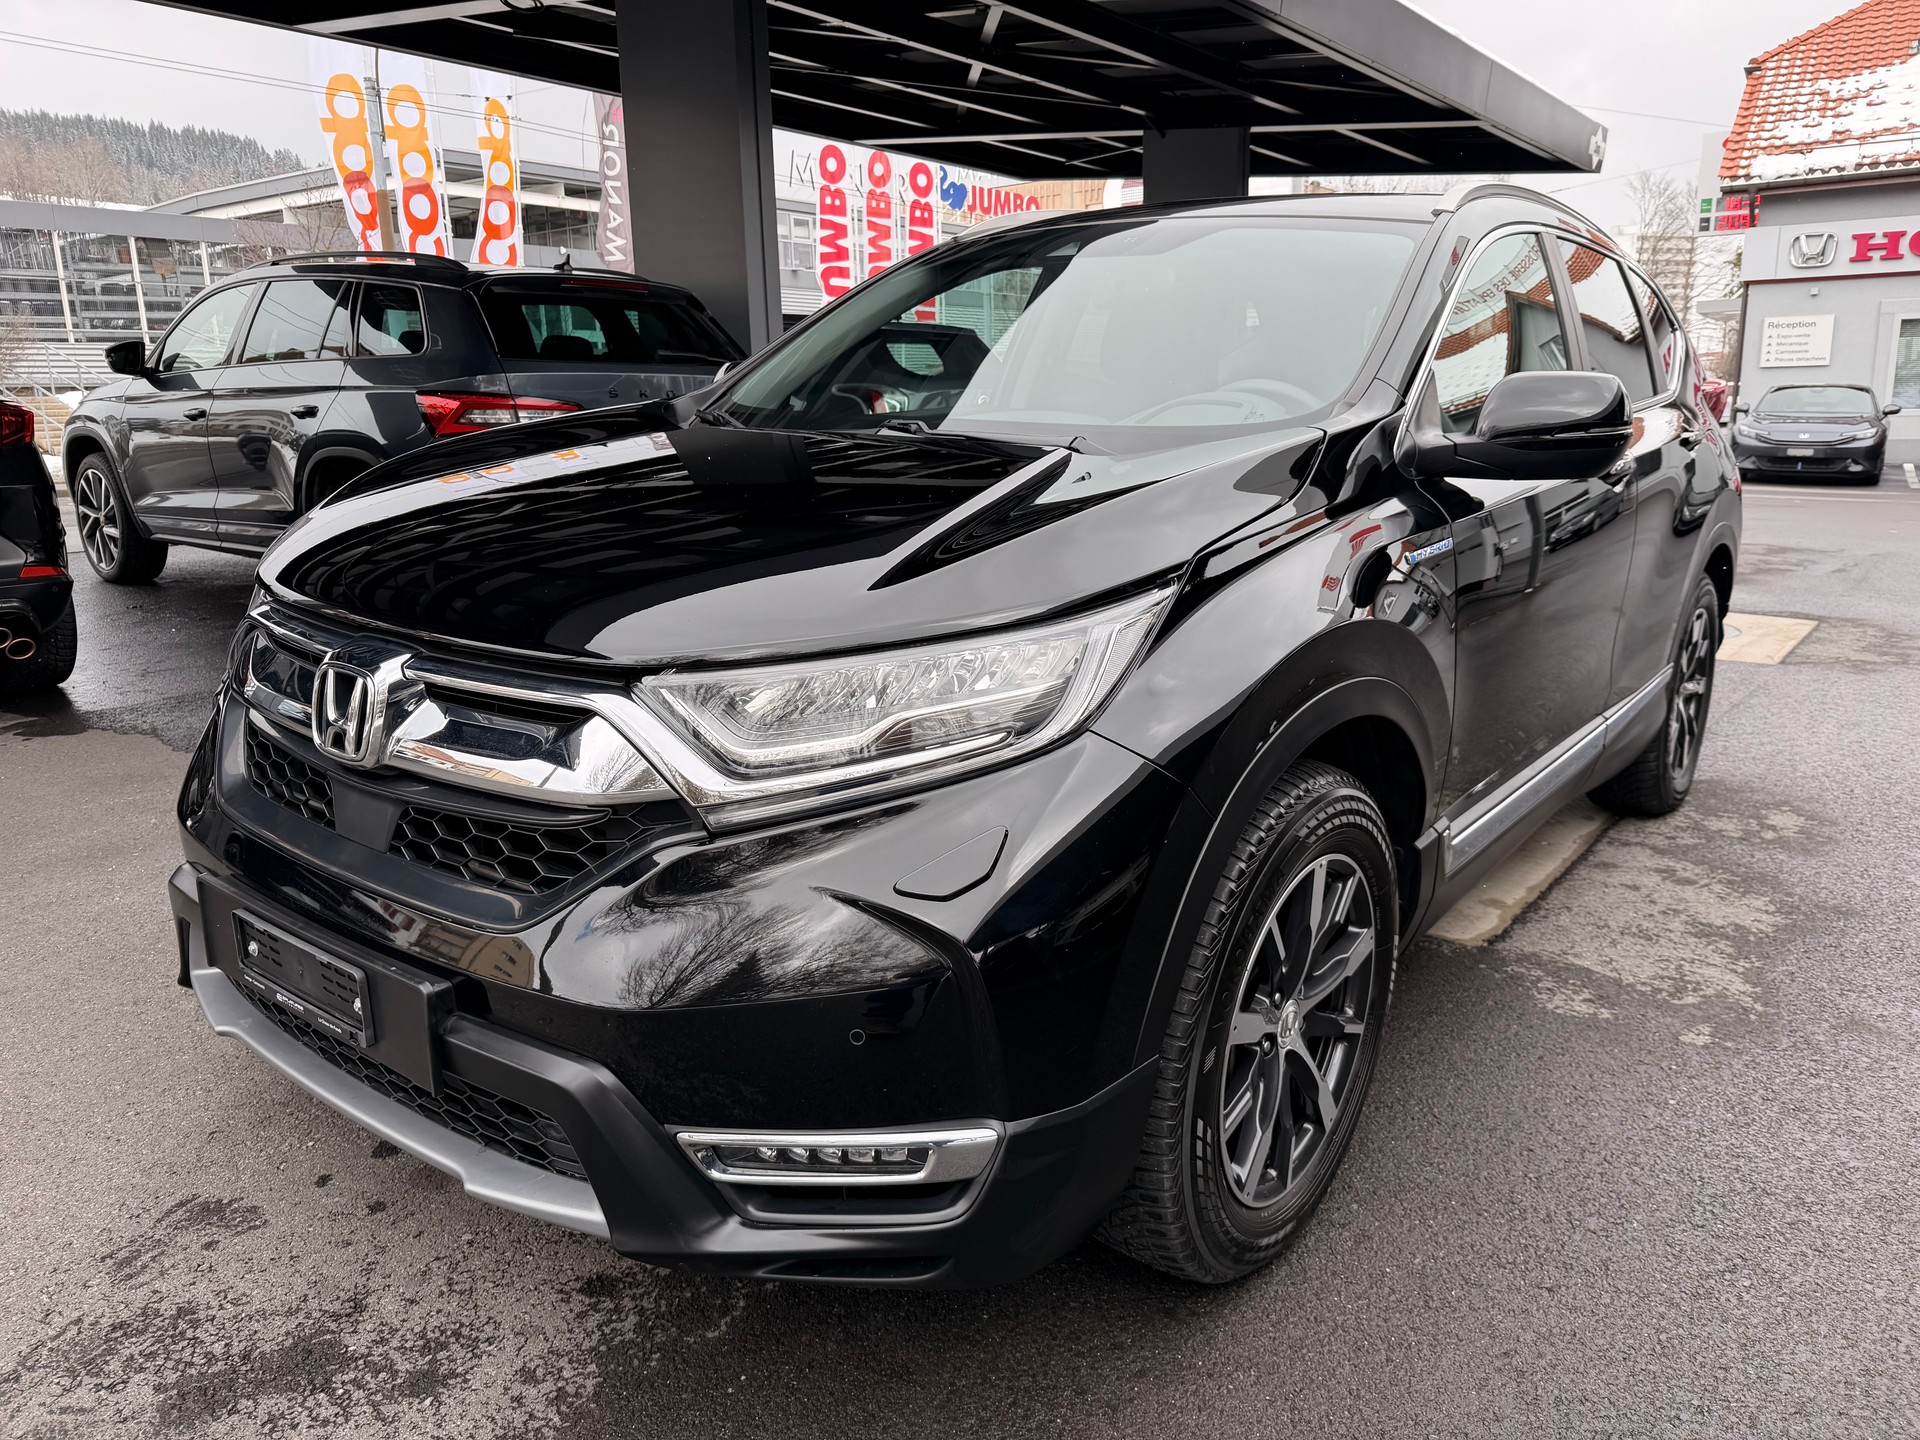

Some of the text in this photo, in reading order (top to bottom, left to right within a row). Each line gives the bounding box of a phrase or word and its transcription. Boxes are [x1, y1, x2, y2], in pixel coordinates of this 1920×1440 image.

[1849, 229, 1920, 262] H
[1767, 320, 1817, 330] Réception
[608, 386, 676, 399] ŠKO
